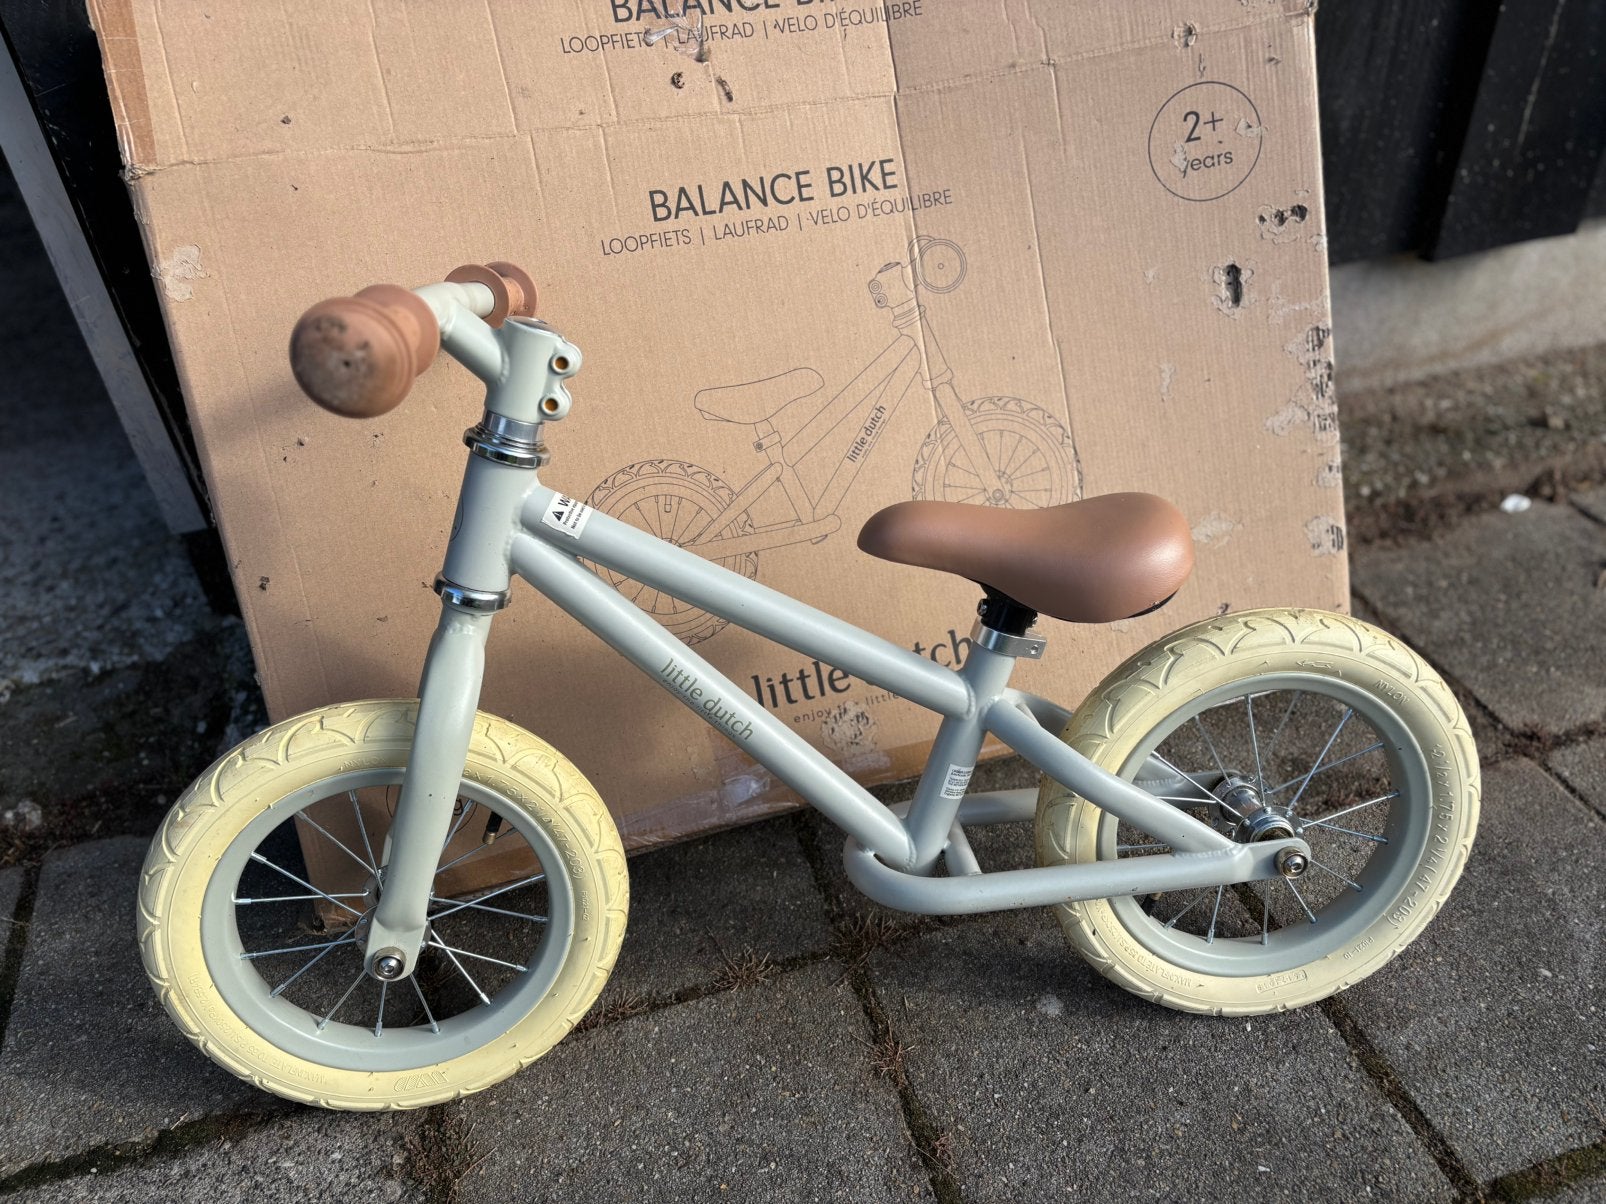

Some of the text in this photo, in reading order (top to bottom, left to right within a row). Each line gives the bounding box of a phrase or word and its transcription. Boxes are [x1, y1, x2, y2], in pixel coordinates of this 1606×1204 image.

[611, 0, 782, 23] BALA
[775, 15, 818, 34] VELO
[1182, 110, 1225, 144] 2+
[648, 158, 898, 222] BALANCE BIKE
[601, 228, 692, 256] LOOPFIETS
[713, 215, 789, 241] LAUFRAD
[808, 206, 851, 226] VELO
[856, 189, 953, 219] D'ÉQUILIBRE
[846, 436, 868, 463] little
[863, 405, 887, 437] dutch
[660, 657, 754, 741] little dutch
[750, 660, 851, 709] little
[793, 707, 833, 724] enjoy
